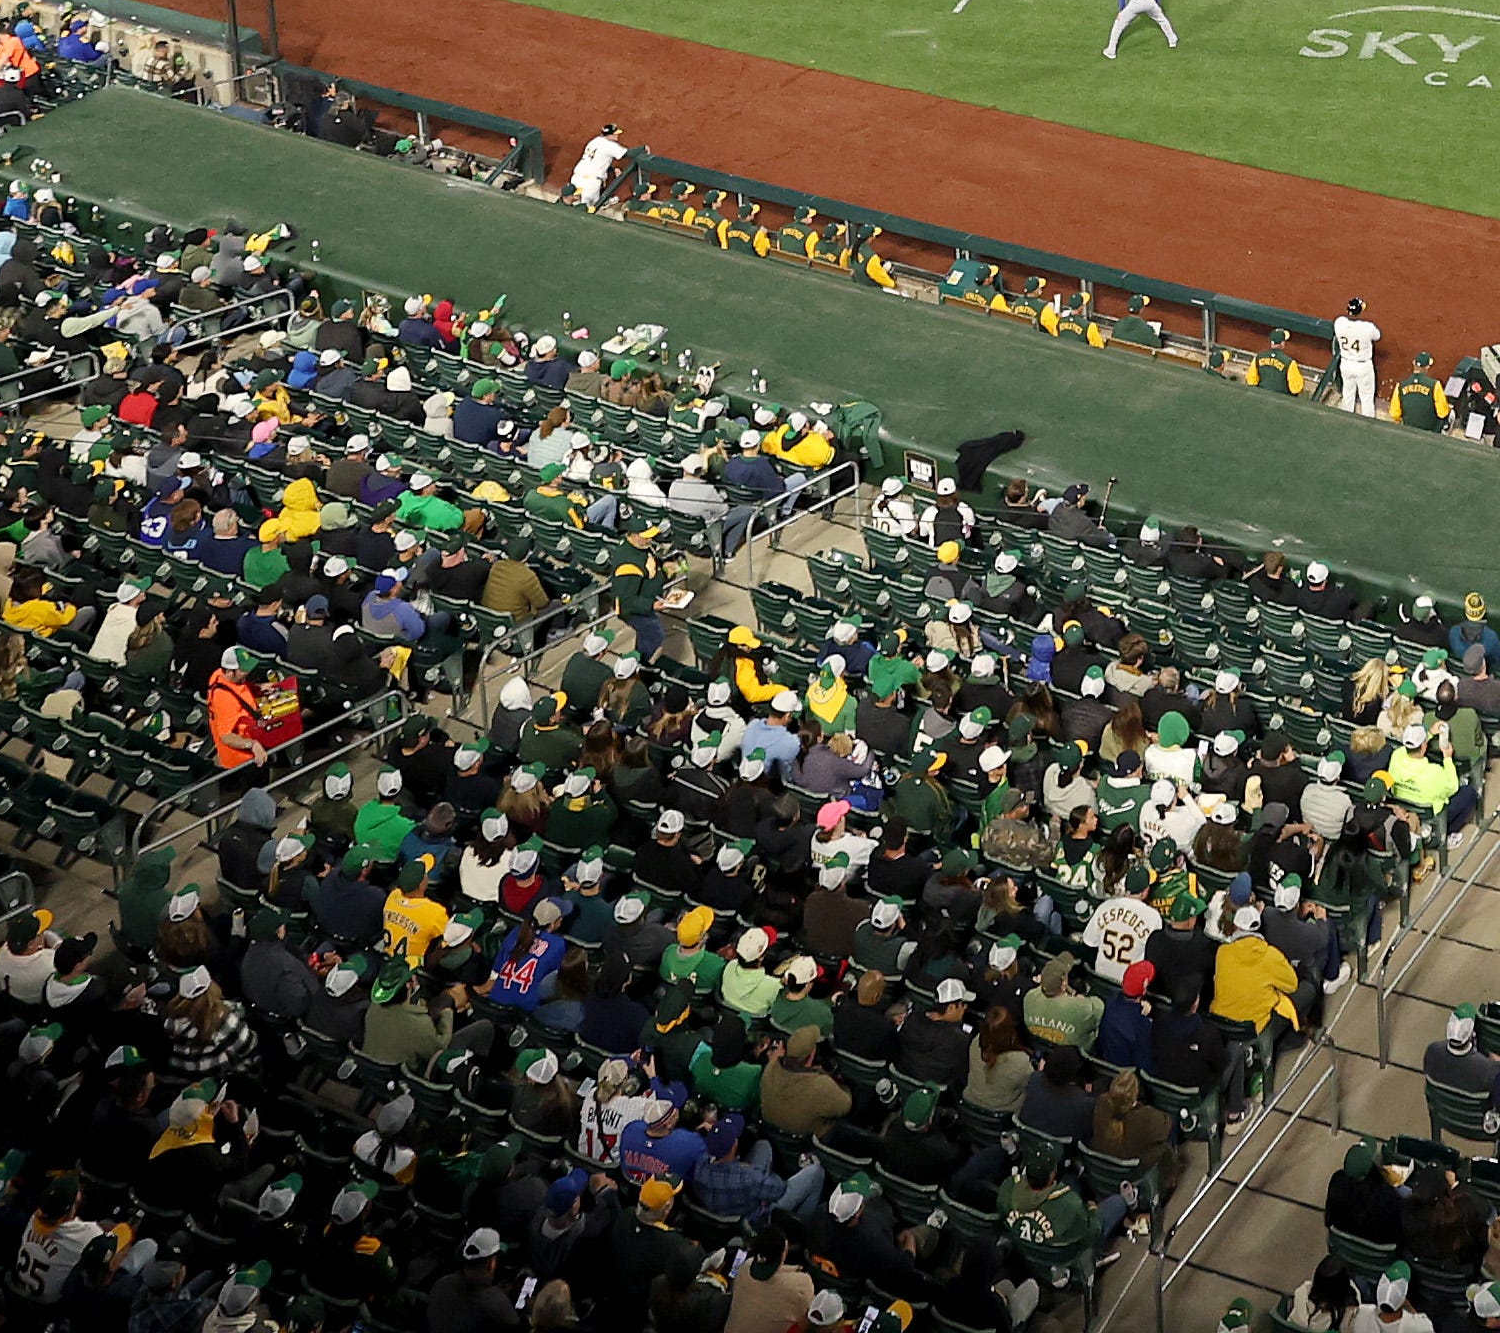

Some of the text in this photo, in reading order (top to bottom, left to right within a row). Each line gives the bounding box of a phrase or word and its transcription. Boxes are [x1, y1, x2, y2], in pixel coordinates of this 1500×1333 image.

[1299, 29, 1485, 64] SKY
[1341, 336, 1360, 352] 24
[1058, 864, 1090, 887] 24
[1097, 908, 1150, 940] CESPEDES
[1103, 929, 1134, 965] 52
[500, 958, 538, 994] 44
[17, 1248, 50, 1294] 25
